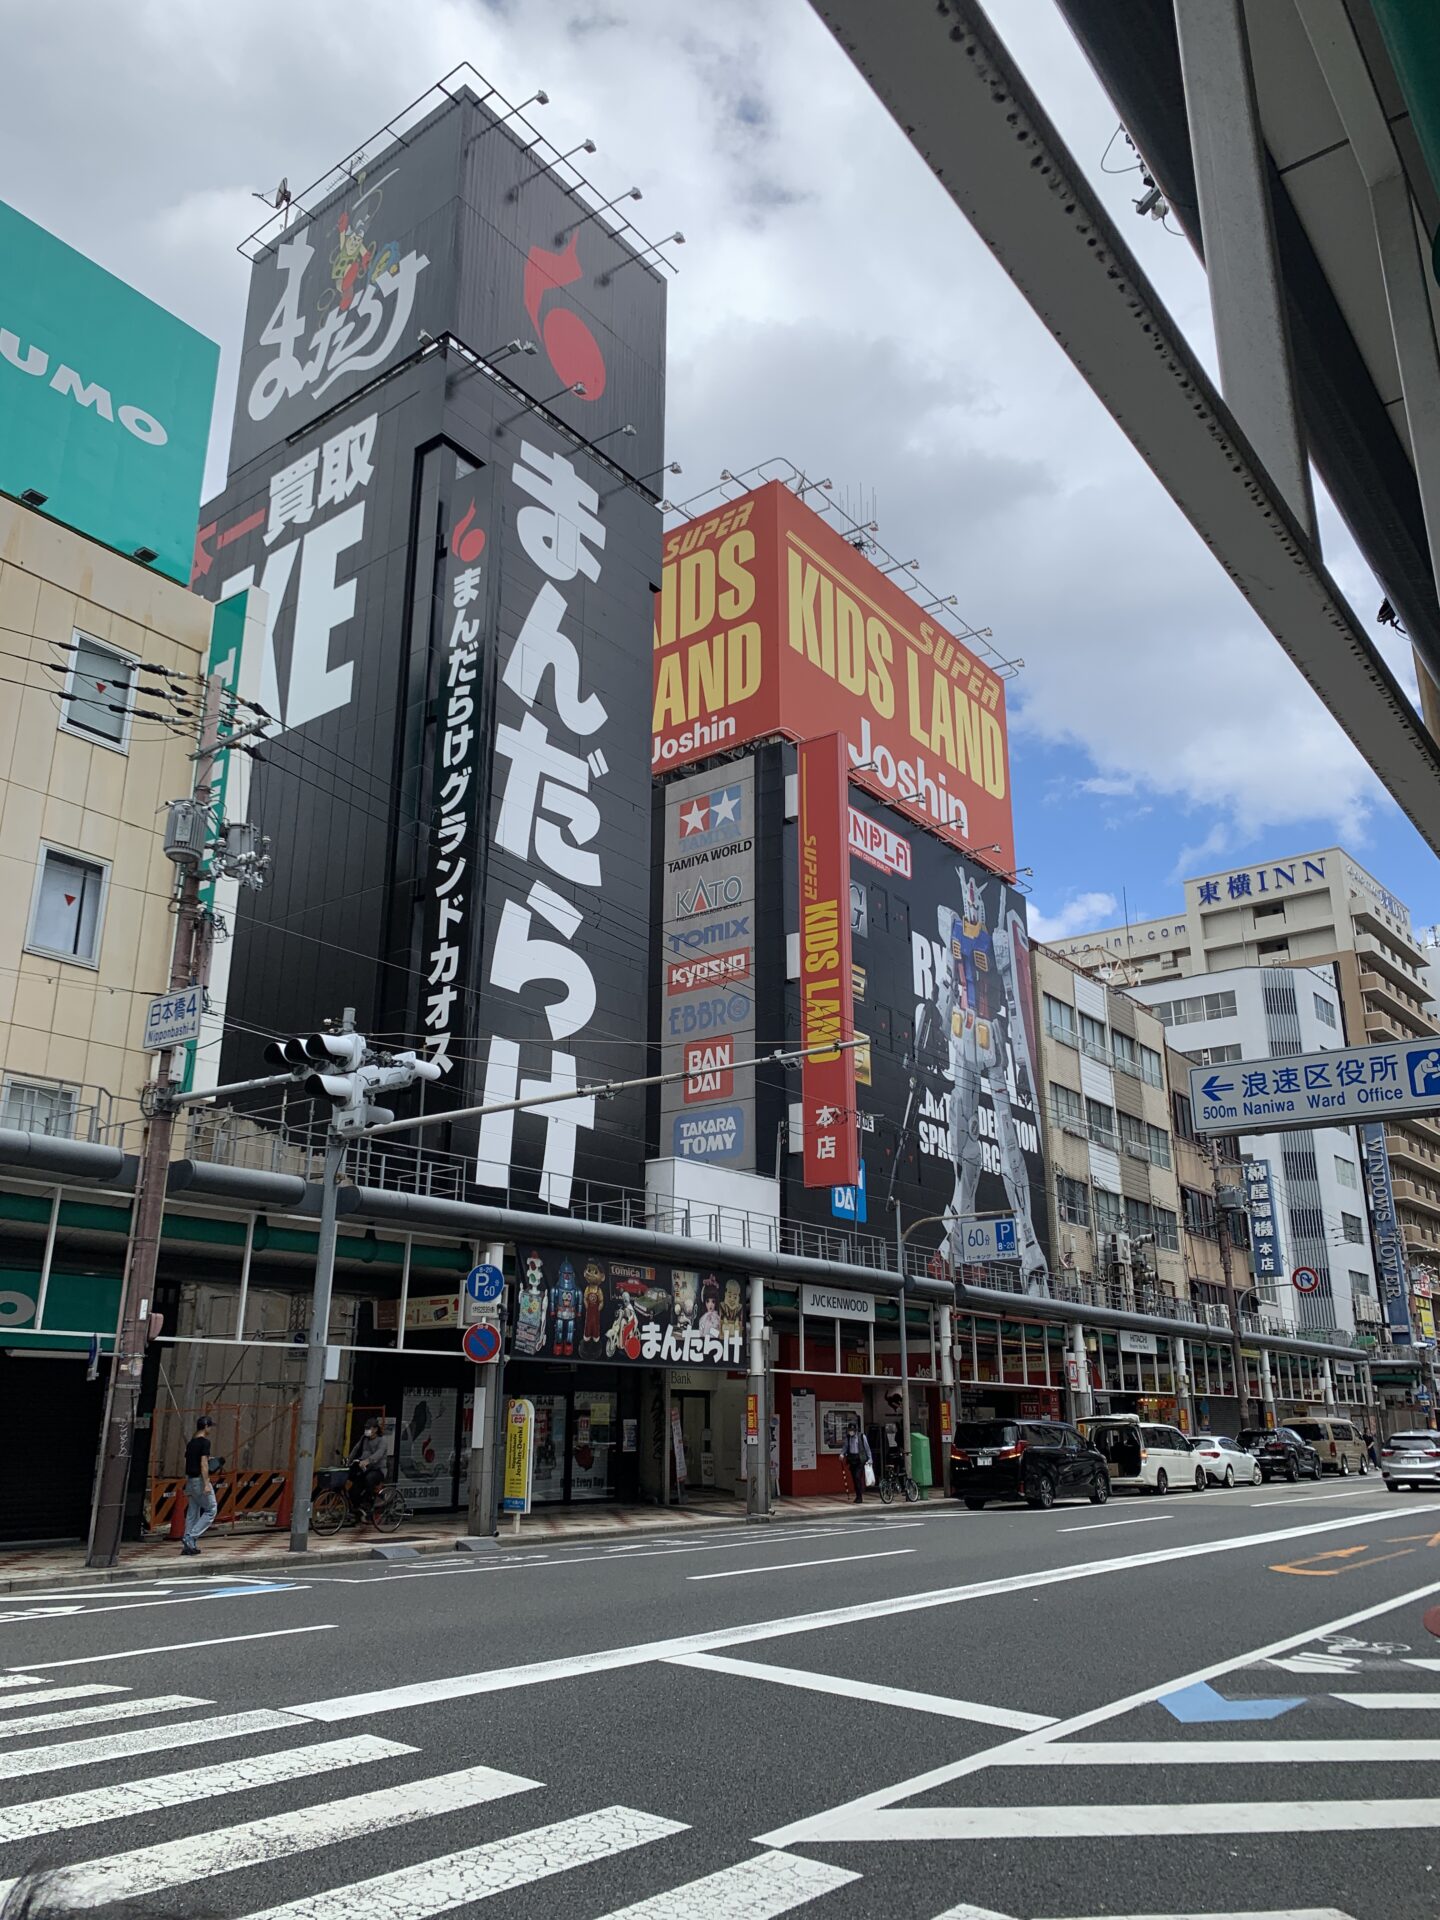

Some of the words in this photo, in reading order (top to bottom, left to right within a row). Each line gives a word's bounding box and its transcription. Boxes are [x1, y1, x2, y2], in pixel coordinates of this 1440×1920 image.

[263, 413, 378, 546] 買取
[663, 500, 755, 563] SUPER
[654, 530, 756, 650] IDS
[787, 546, 895, 720] KIDS
[907, 646, 1006, 800] LAND
[920, 622, 1000, 712] SUPER
[652, 715, 737, 764] Joshin
[848, 717, 969, 839] Joshin
[425, 566, 482, 1075] まんだらけグランドカオス
[476, 439, 609, 1209] まんだらけ
[668, 852, 710, 873] TAMIYA
[710, 840, 752, 861] WORLD
[803, 834, 818, 900] SUPER
[675, 875, 742, 918] KATO
[1196, 857, 1326, 906] 東横INN
[668, 916, 750, 953] TOMIX
[805, 900, 840, 973] KIDS
[150, 992, 197, 1028] 日本橋4
[668, 994, 750, 1035] EBBRO
[806, 978, 841, 1064] LAND
[688, 1044, 730, 1073] BAN
[1241, 1054, 1399, 1099] 浪速区役所
[688, 1072, 721, 1095] DAI
[1203, 1105, 1238, 1120] 500m
[1243, 1100, 1295, 1116] Naniwa
[1307, 1092, 1346, 1109] Ward
[1357, 1087, 1404, 1104] Office
[679, 1132, 737, 1156] TOMY
[680, 1116, 737, 1138] TAKARA
[815, 1105, 840, 1160] 本店
[919, 1120, 954, 1163] SPAC
[1367, 1137, 1392, 1223] WINDOWS
[998, 1241, 1015, 1250] 8-20
[1000, 1223, 1010, 1241] P
[475, 1273, 490, 1297] P
[611, 1265, 640, 1278] tomica
[811, 1293, 869, 1313] JVCKENWOOD
[671, 1370, 692, 1386] Bank
[515, 1426, 524, 1477] Joshin-Denki
